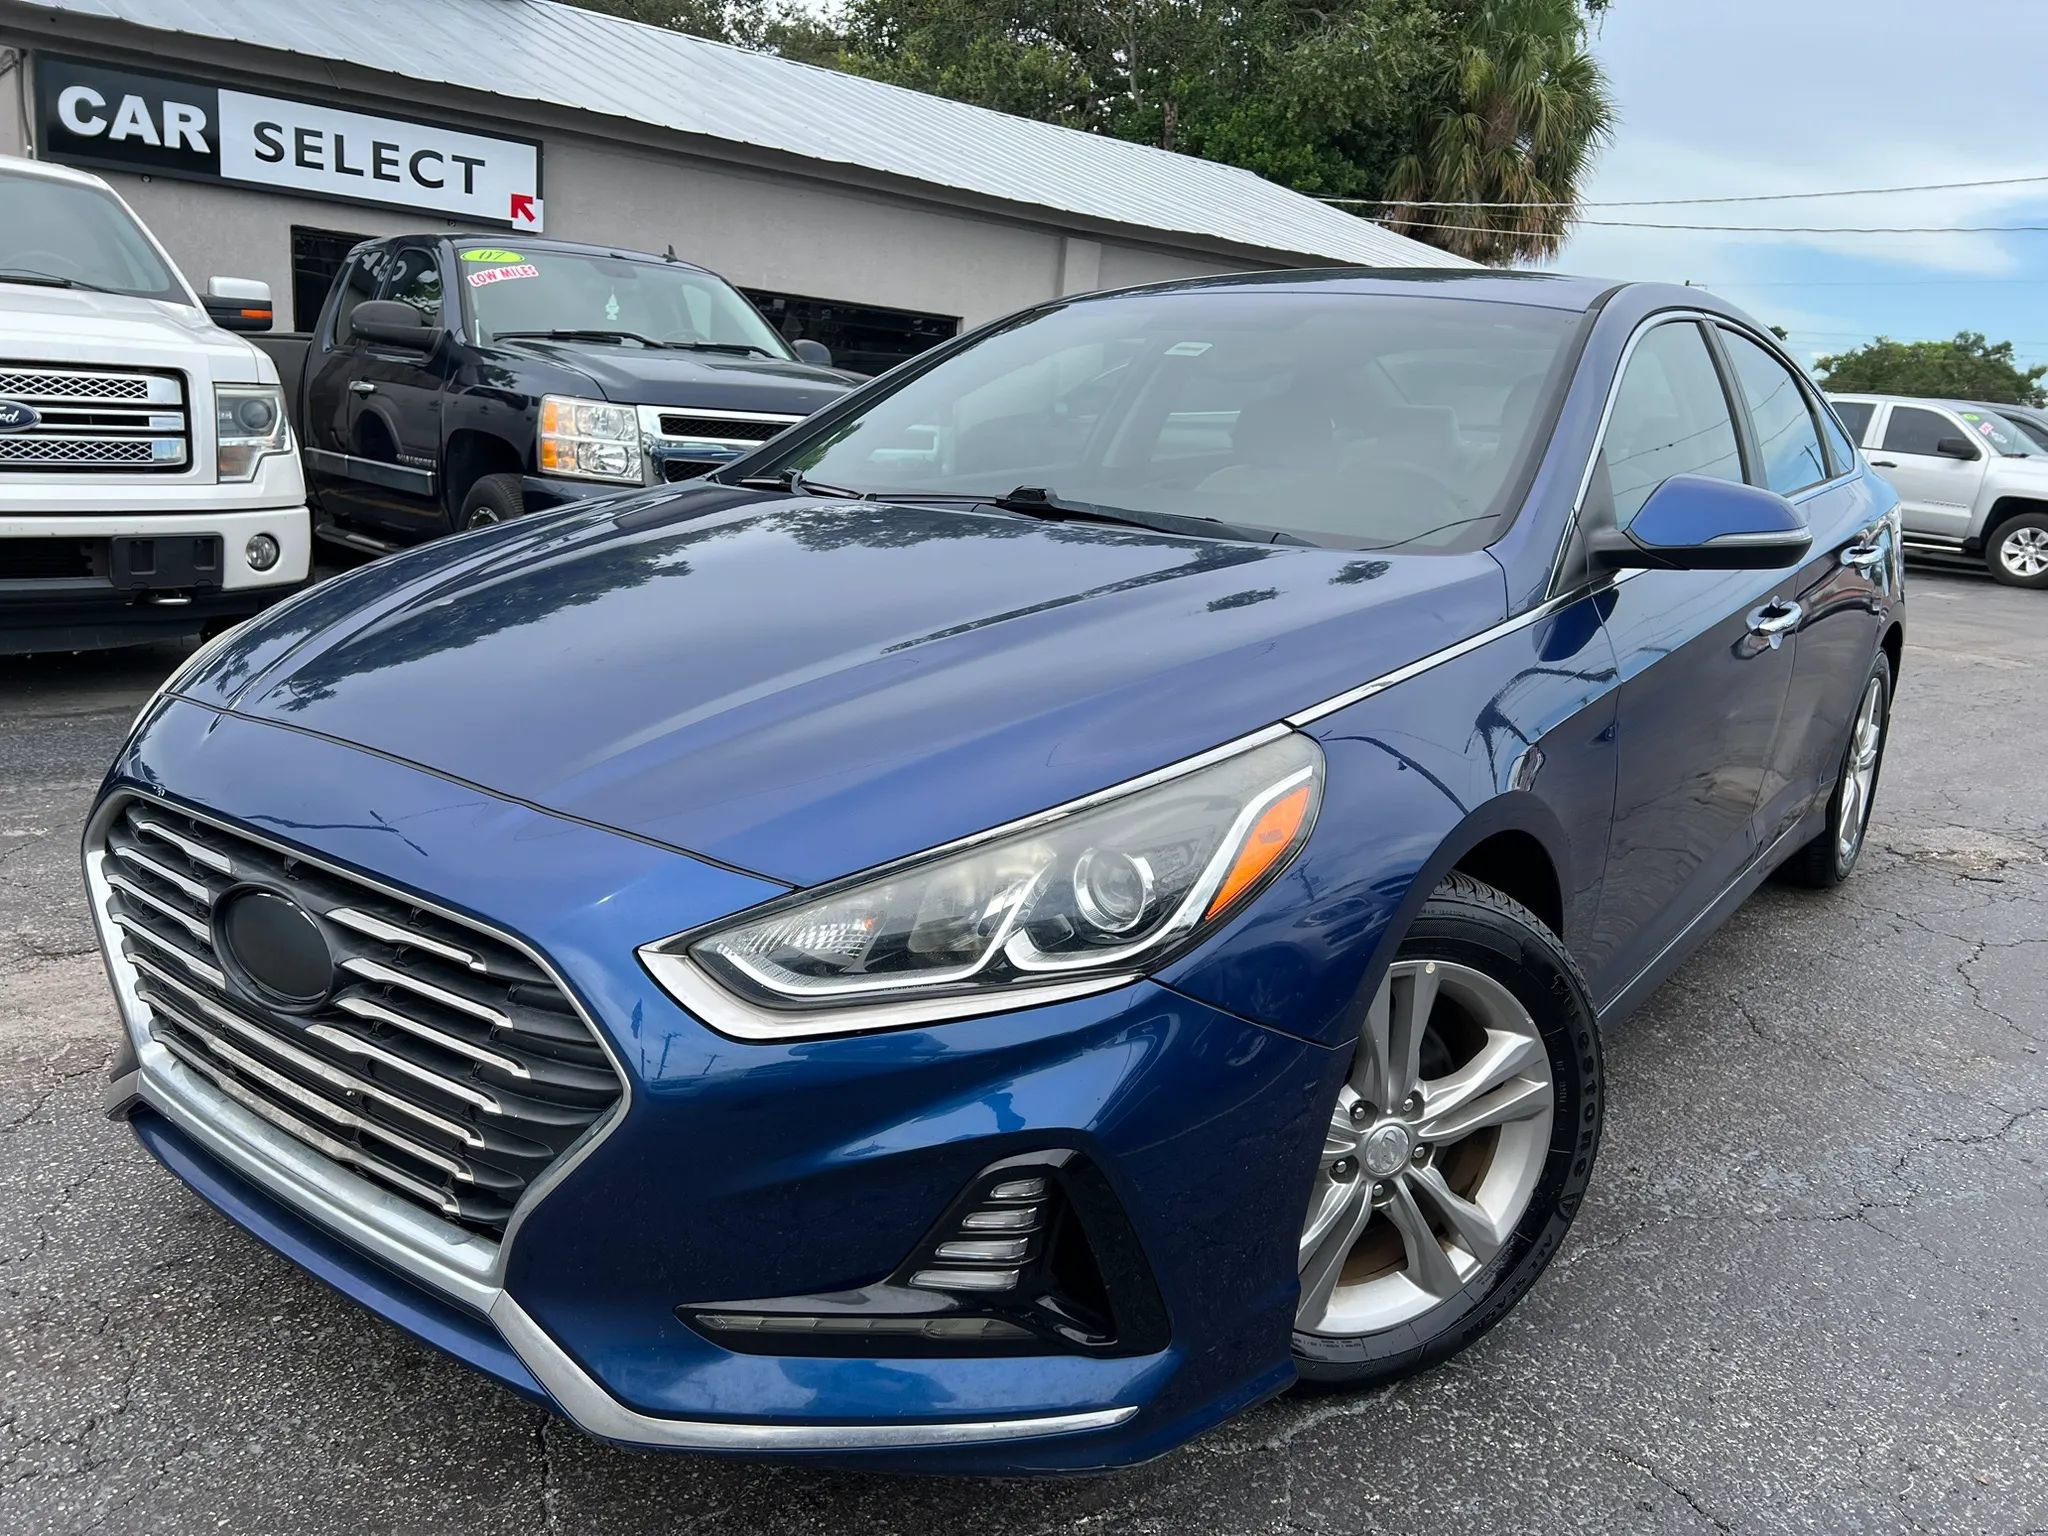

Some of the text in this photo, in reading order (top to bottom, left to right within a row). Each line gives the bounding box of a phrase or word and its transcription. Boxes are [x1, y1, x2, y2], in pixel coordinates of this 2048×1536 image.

[57, 85, 486, 195] CAR SELECT
[469, 271, 497, 286] LOW
